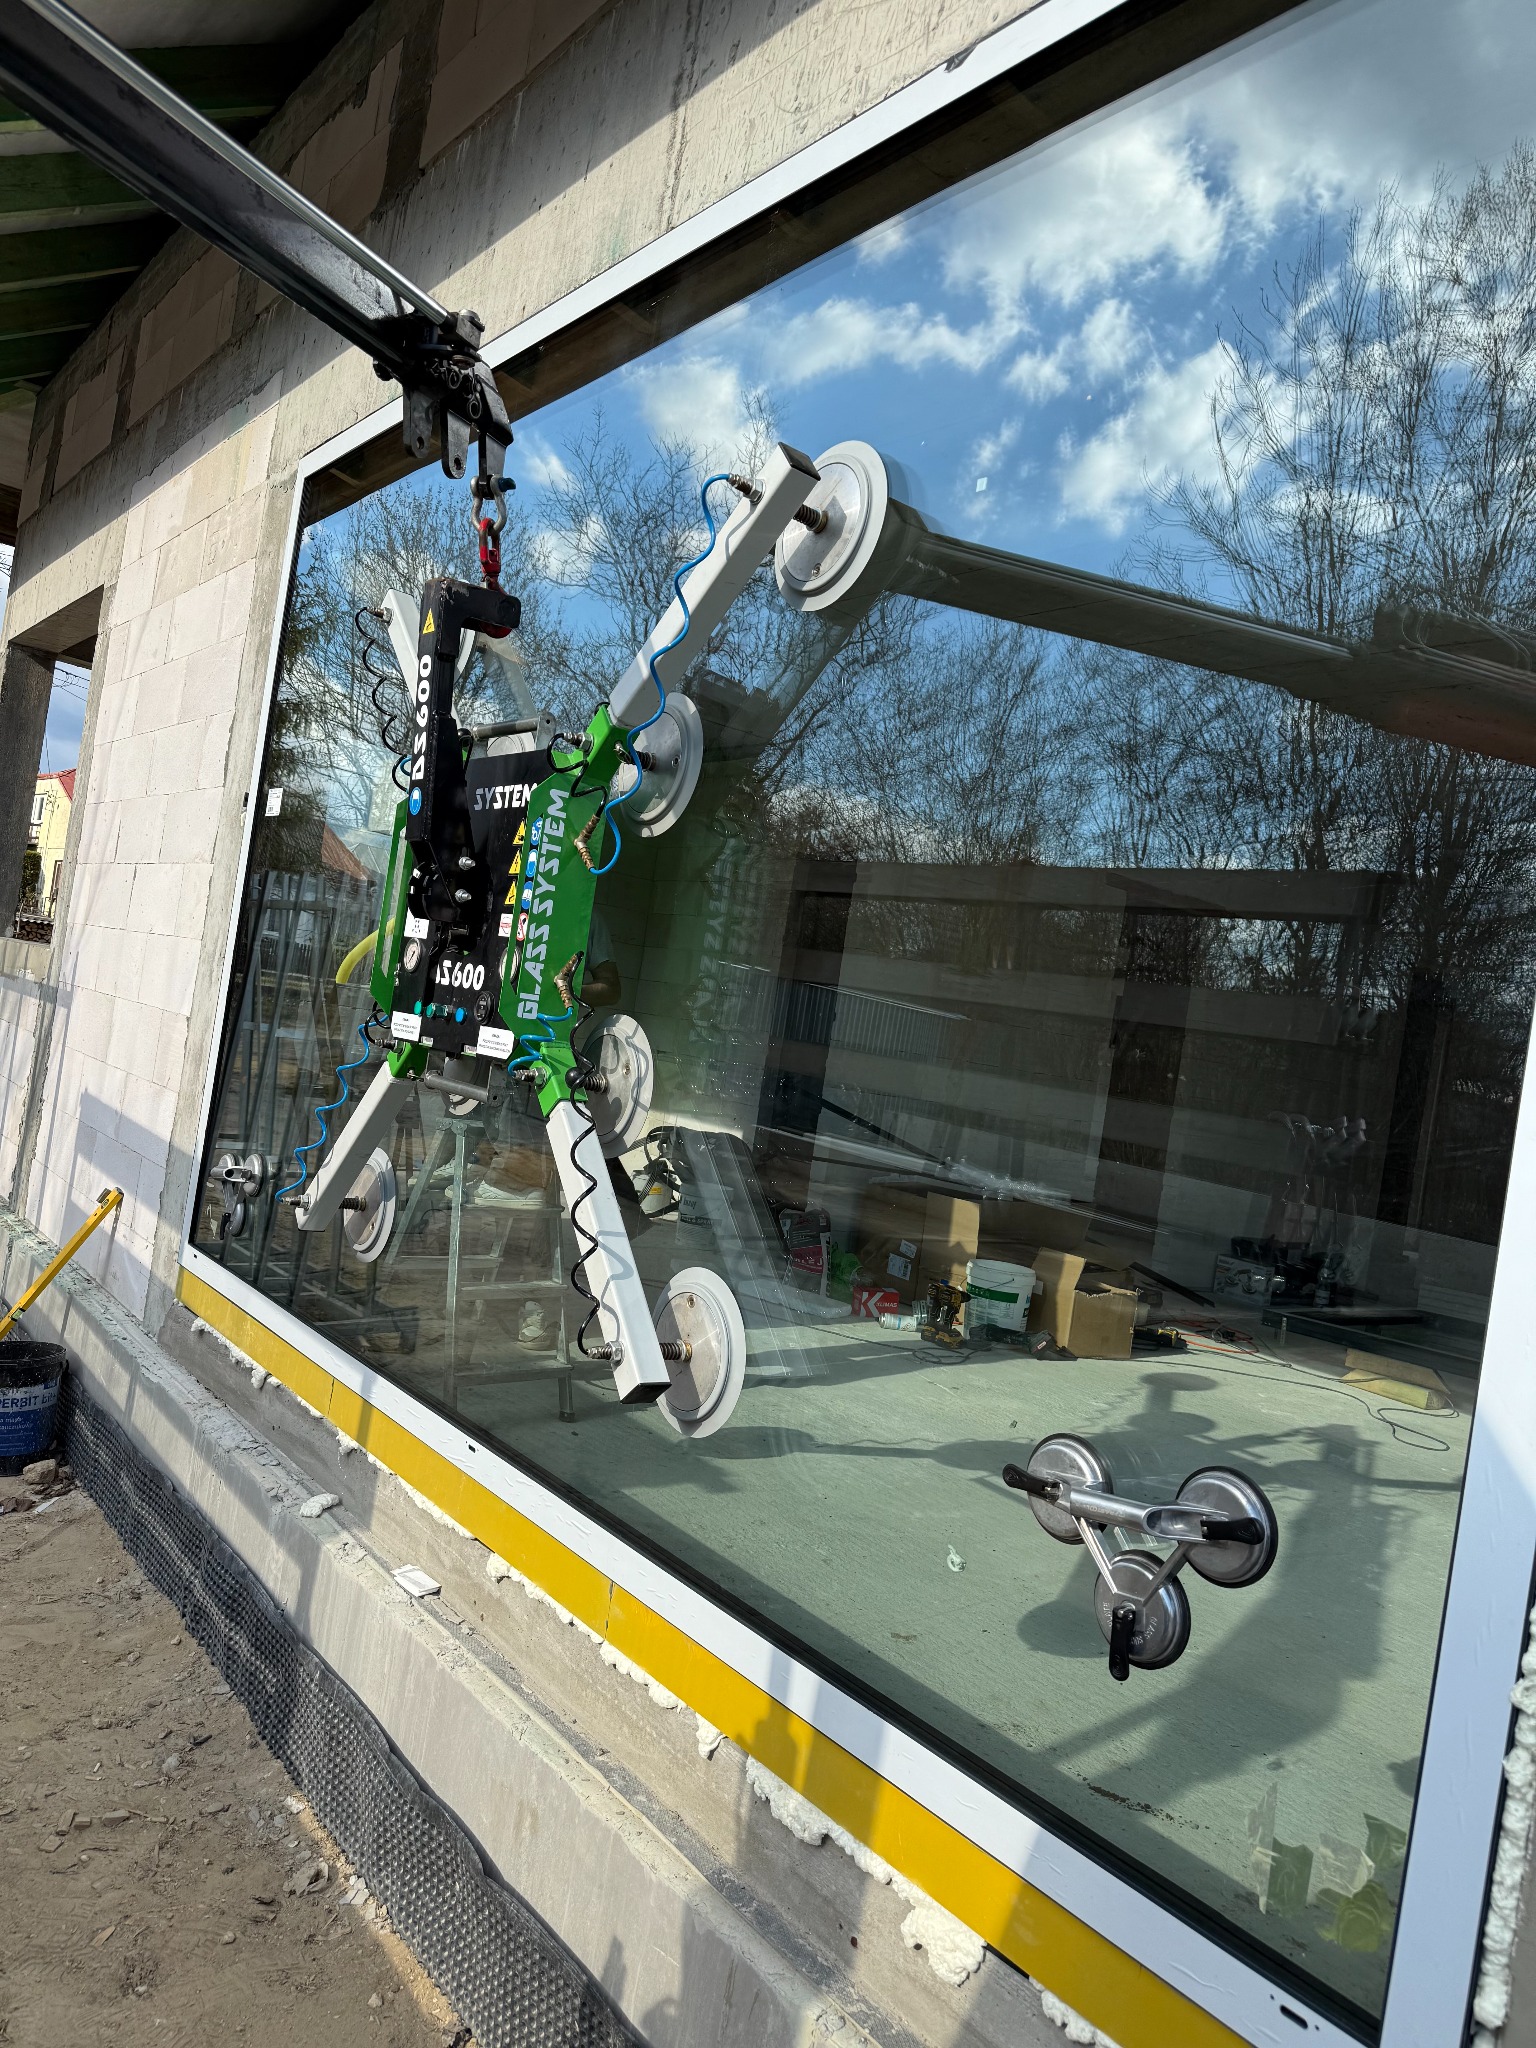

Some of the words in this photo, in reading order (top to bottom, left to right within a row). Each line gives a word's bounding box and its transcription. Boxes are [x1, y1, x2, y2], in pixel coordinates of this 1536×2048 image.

[411, 654, 432, 781] DS600
[531, 787, 570, 917] SYSTEM
[516, 922, 550, 1020] GLASS
